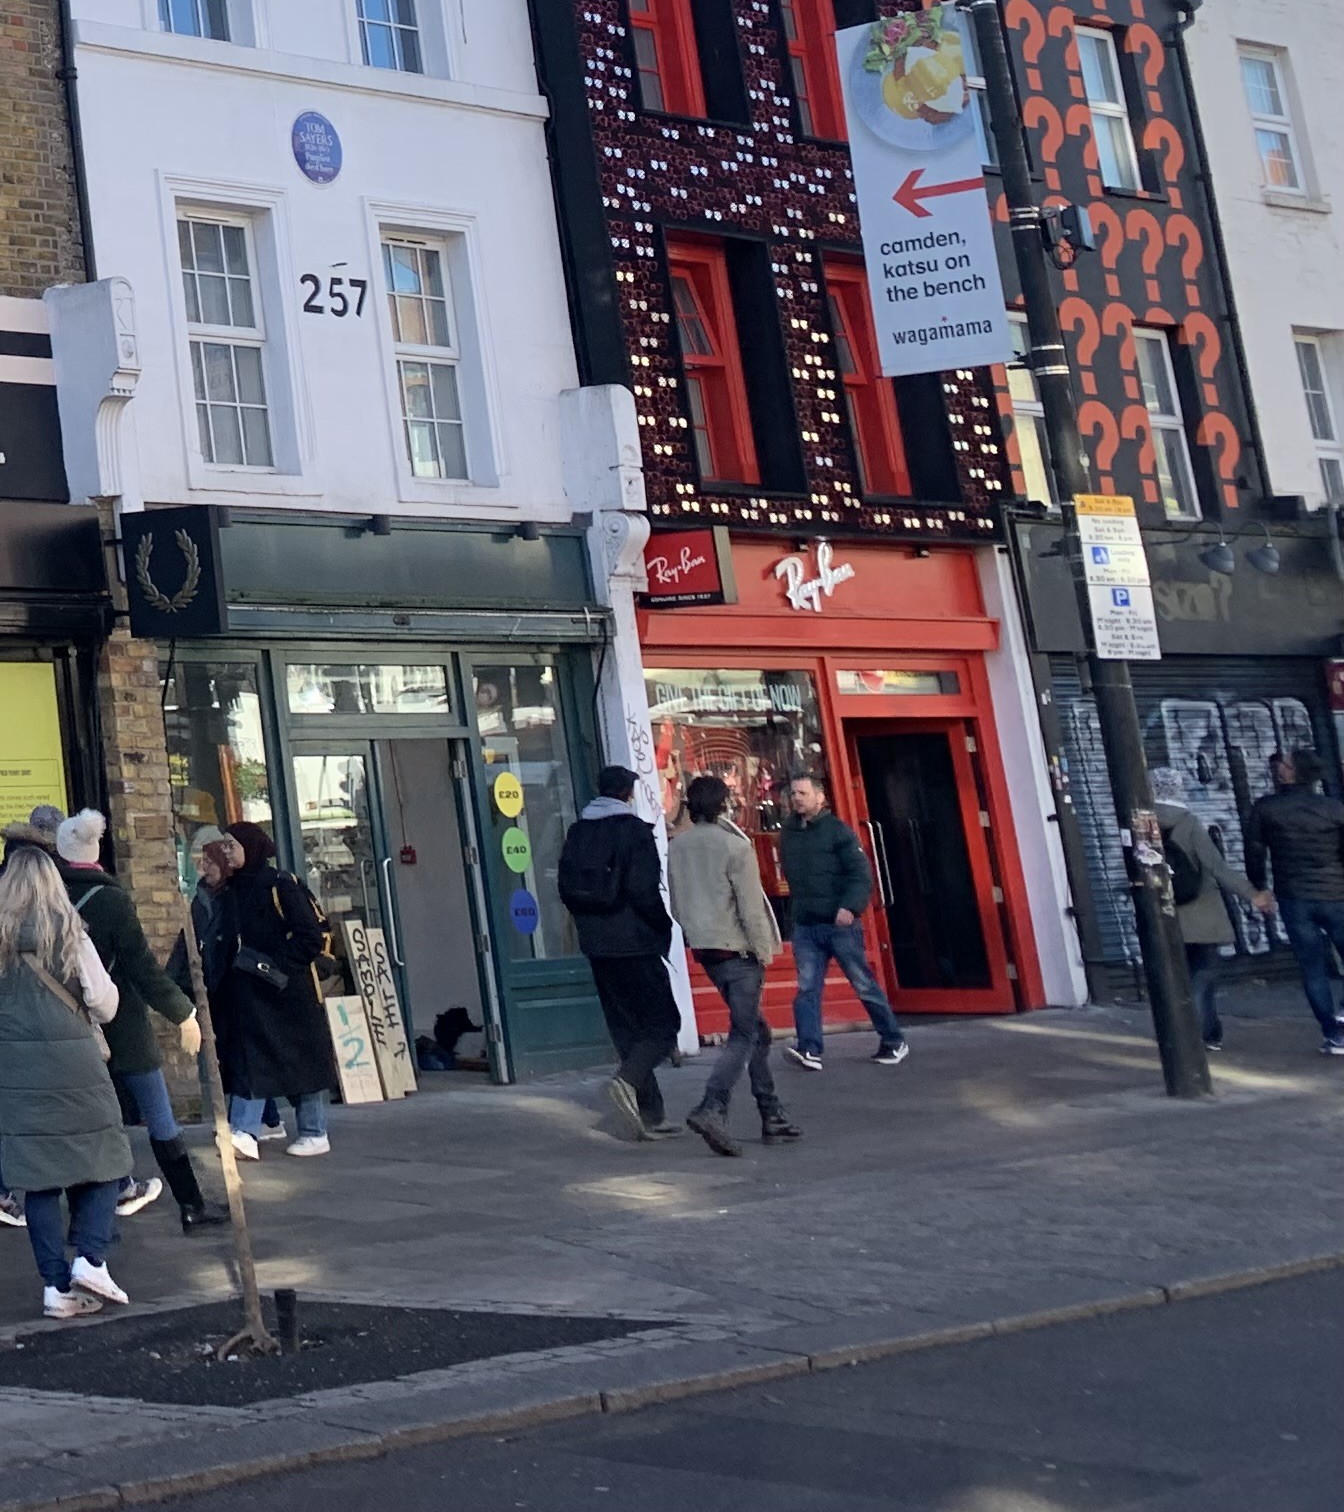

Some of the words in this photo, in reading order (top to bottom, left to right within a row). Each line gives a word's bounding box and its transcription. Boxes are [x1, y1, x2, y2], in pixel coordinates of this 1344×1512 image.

[299, 132, 333, 146] SAYERS
[880, 231, 966, 256] camden,
[883, 258, 938, 279] katsu
[945, 253, 970, 269] on
[299, 273, 368, 318] 257
[886, 285, 918, 302] the
[923, 274, 986, 298] bench
[892, 319, 993, 346] wagamama
[769, 684, 803, 712] NOW
